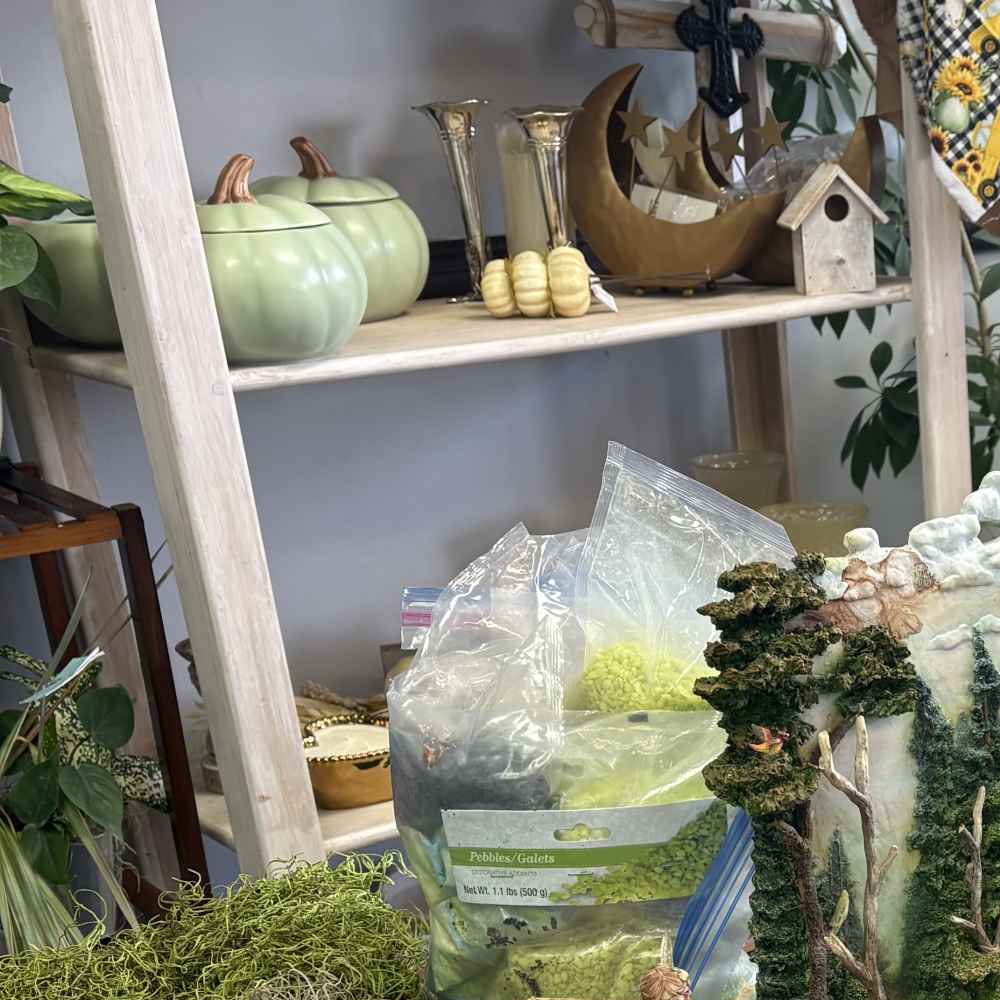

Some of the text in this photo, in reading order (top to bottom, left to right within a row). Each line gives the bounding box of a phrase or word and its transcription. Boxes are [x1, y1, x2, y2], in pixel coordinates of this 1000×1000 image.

[469, 851, 555, 864] Pebbles/Galets
[463, 885, 477, 895] Net
[492, 887, 504, 896] 1.1
[506, 887, 518, 897] lbs
[519, 887, 538, 898] (500
[539, 888, 548, 898] g)
